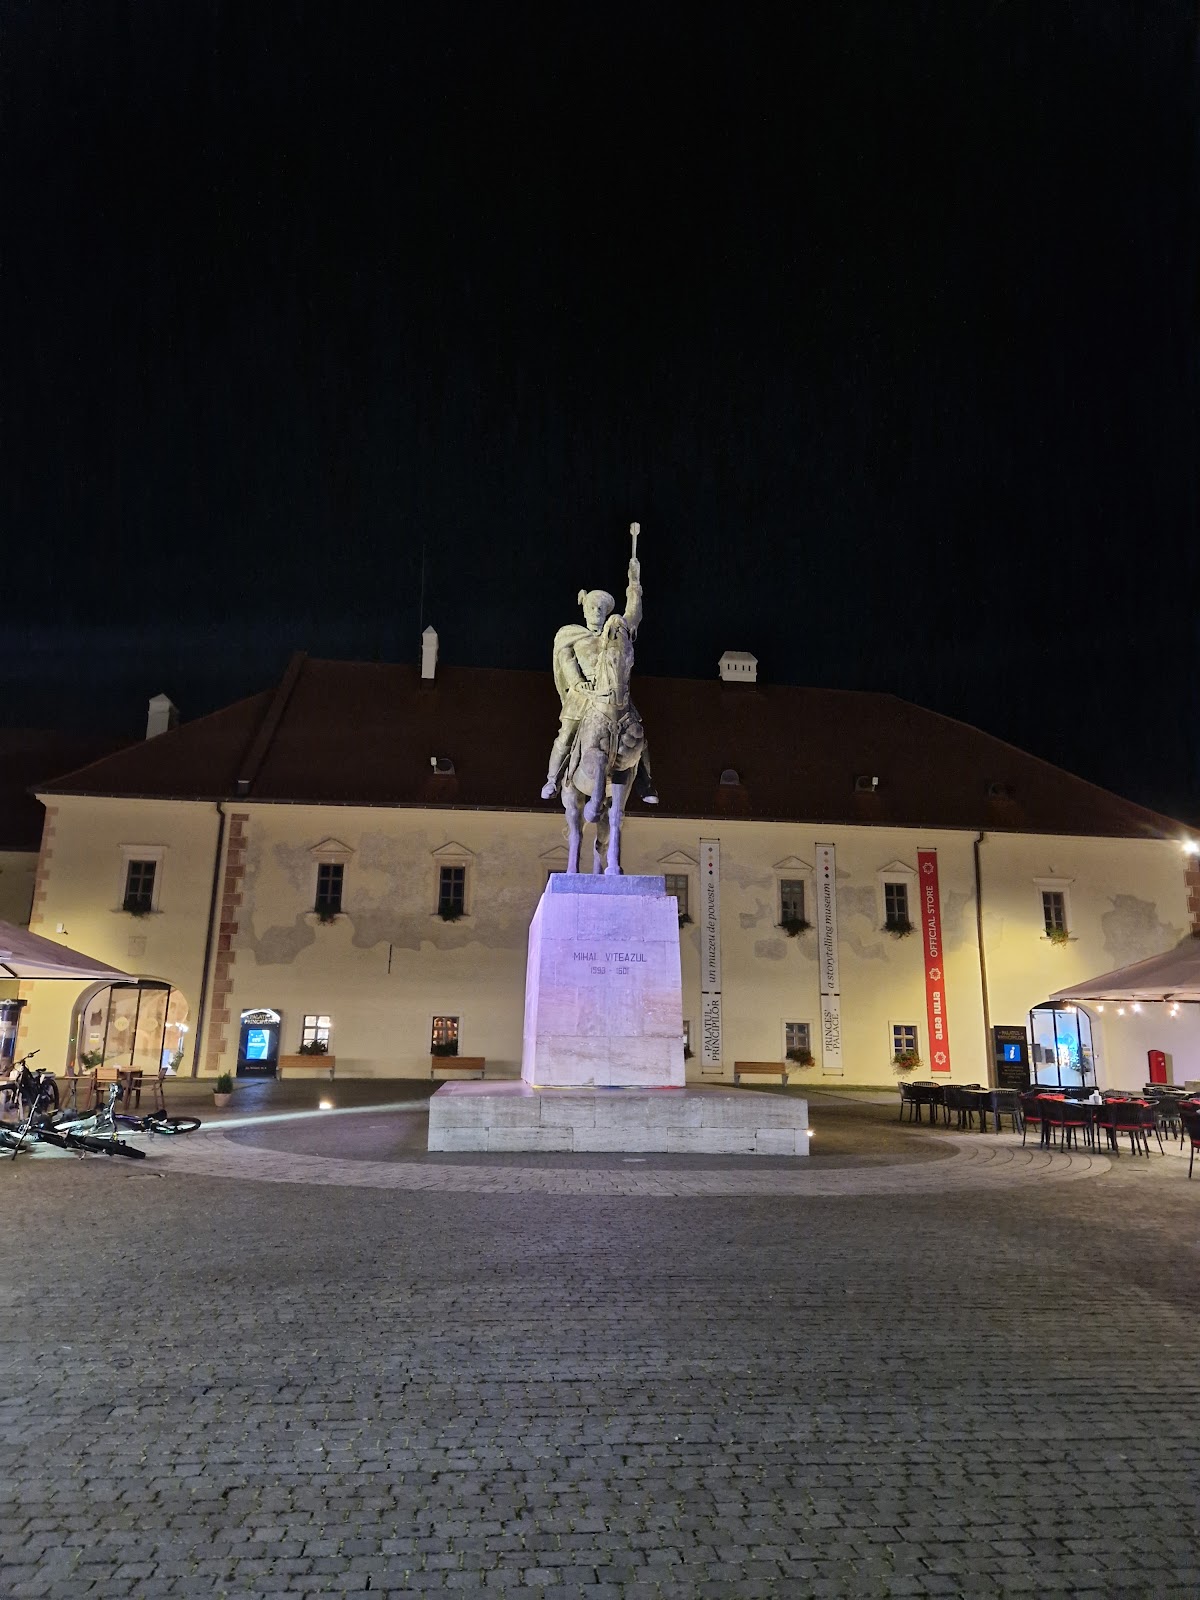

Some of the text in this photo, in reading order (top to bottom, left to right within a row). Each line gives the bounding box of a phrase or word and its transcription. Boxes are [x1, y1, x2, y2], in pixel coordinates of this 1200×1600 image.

[823, 883, 832, 925] museum
[926, 885, 938, 958] OFFICIAL STORE
[706, 883, 717, 983] un muzeu de poveste
[823, 926, 835, 981] storytelling
[573, 952, 648, 963] MIHAI VITEAZUL
[704, 1009, 712, 1051] PALATUL
[712, 1000, 720, 1061] PRINCIPILOR
[832, 1013, 840, 1049] PALACE
